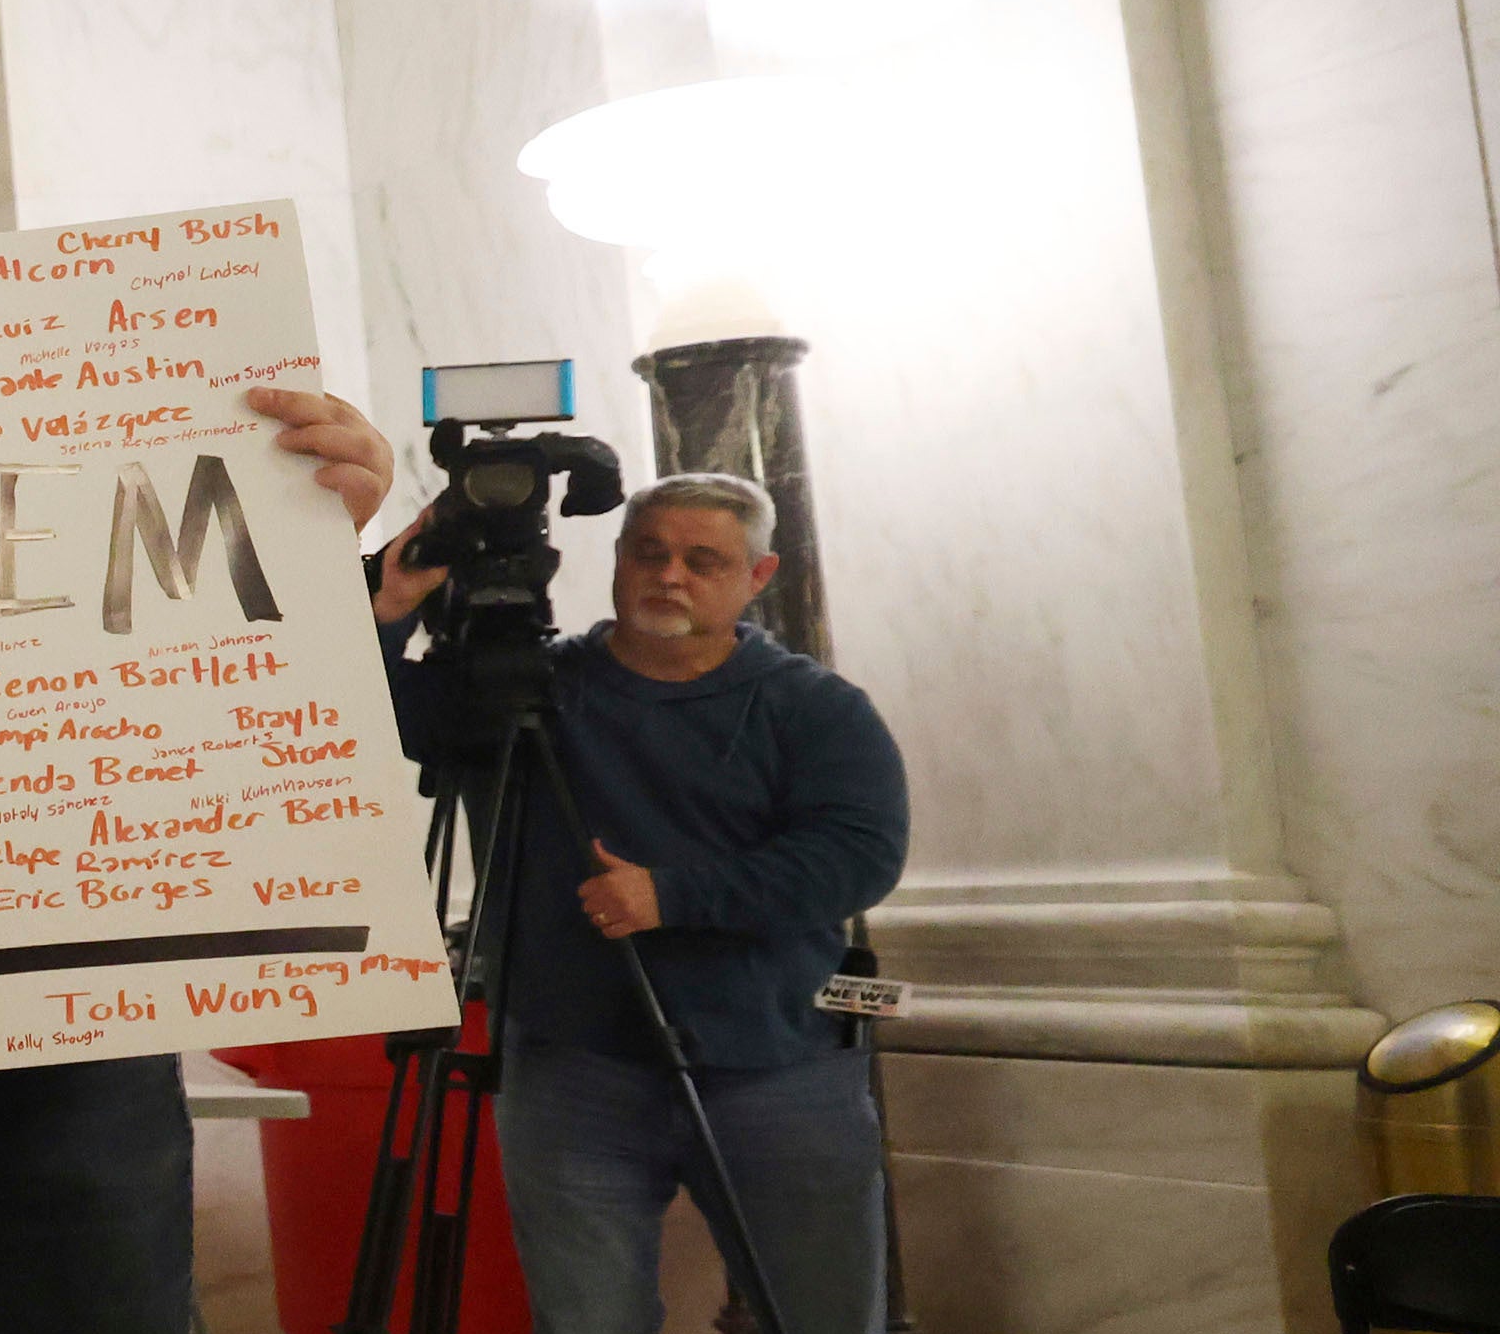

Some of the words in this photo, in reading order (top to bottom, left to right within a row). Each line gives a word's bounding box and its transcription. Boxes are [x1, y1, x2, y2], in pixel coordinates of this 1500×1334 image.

[57, 227, 161, 254] Cherry
[179, 213, 280, 245] Bush
[108, 299, 219, 333] Arsen
[76, 356, 205, 390] Austin
[110, 651, 289, 688] Bartlett
[228, 701, 340, 737] Brayla
[259, 738, 358, 768] Stone
[88, 756, 204, 787] Benet
[89, 803, 265, 847] Alexander
[280, 795, 384, 825] Betts
[44, 989, 157, 1024] Tobi
[185, 983, 318, 1018] Wong
